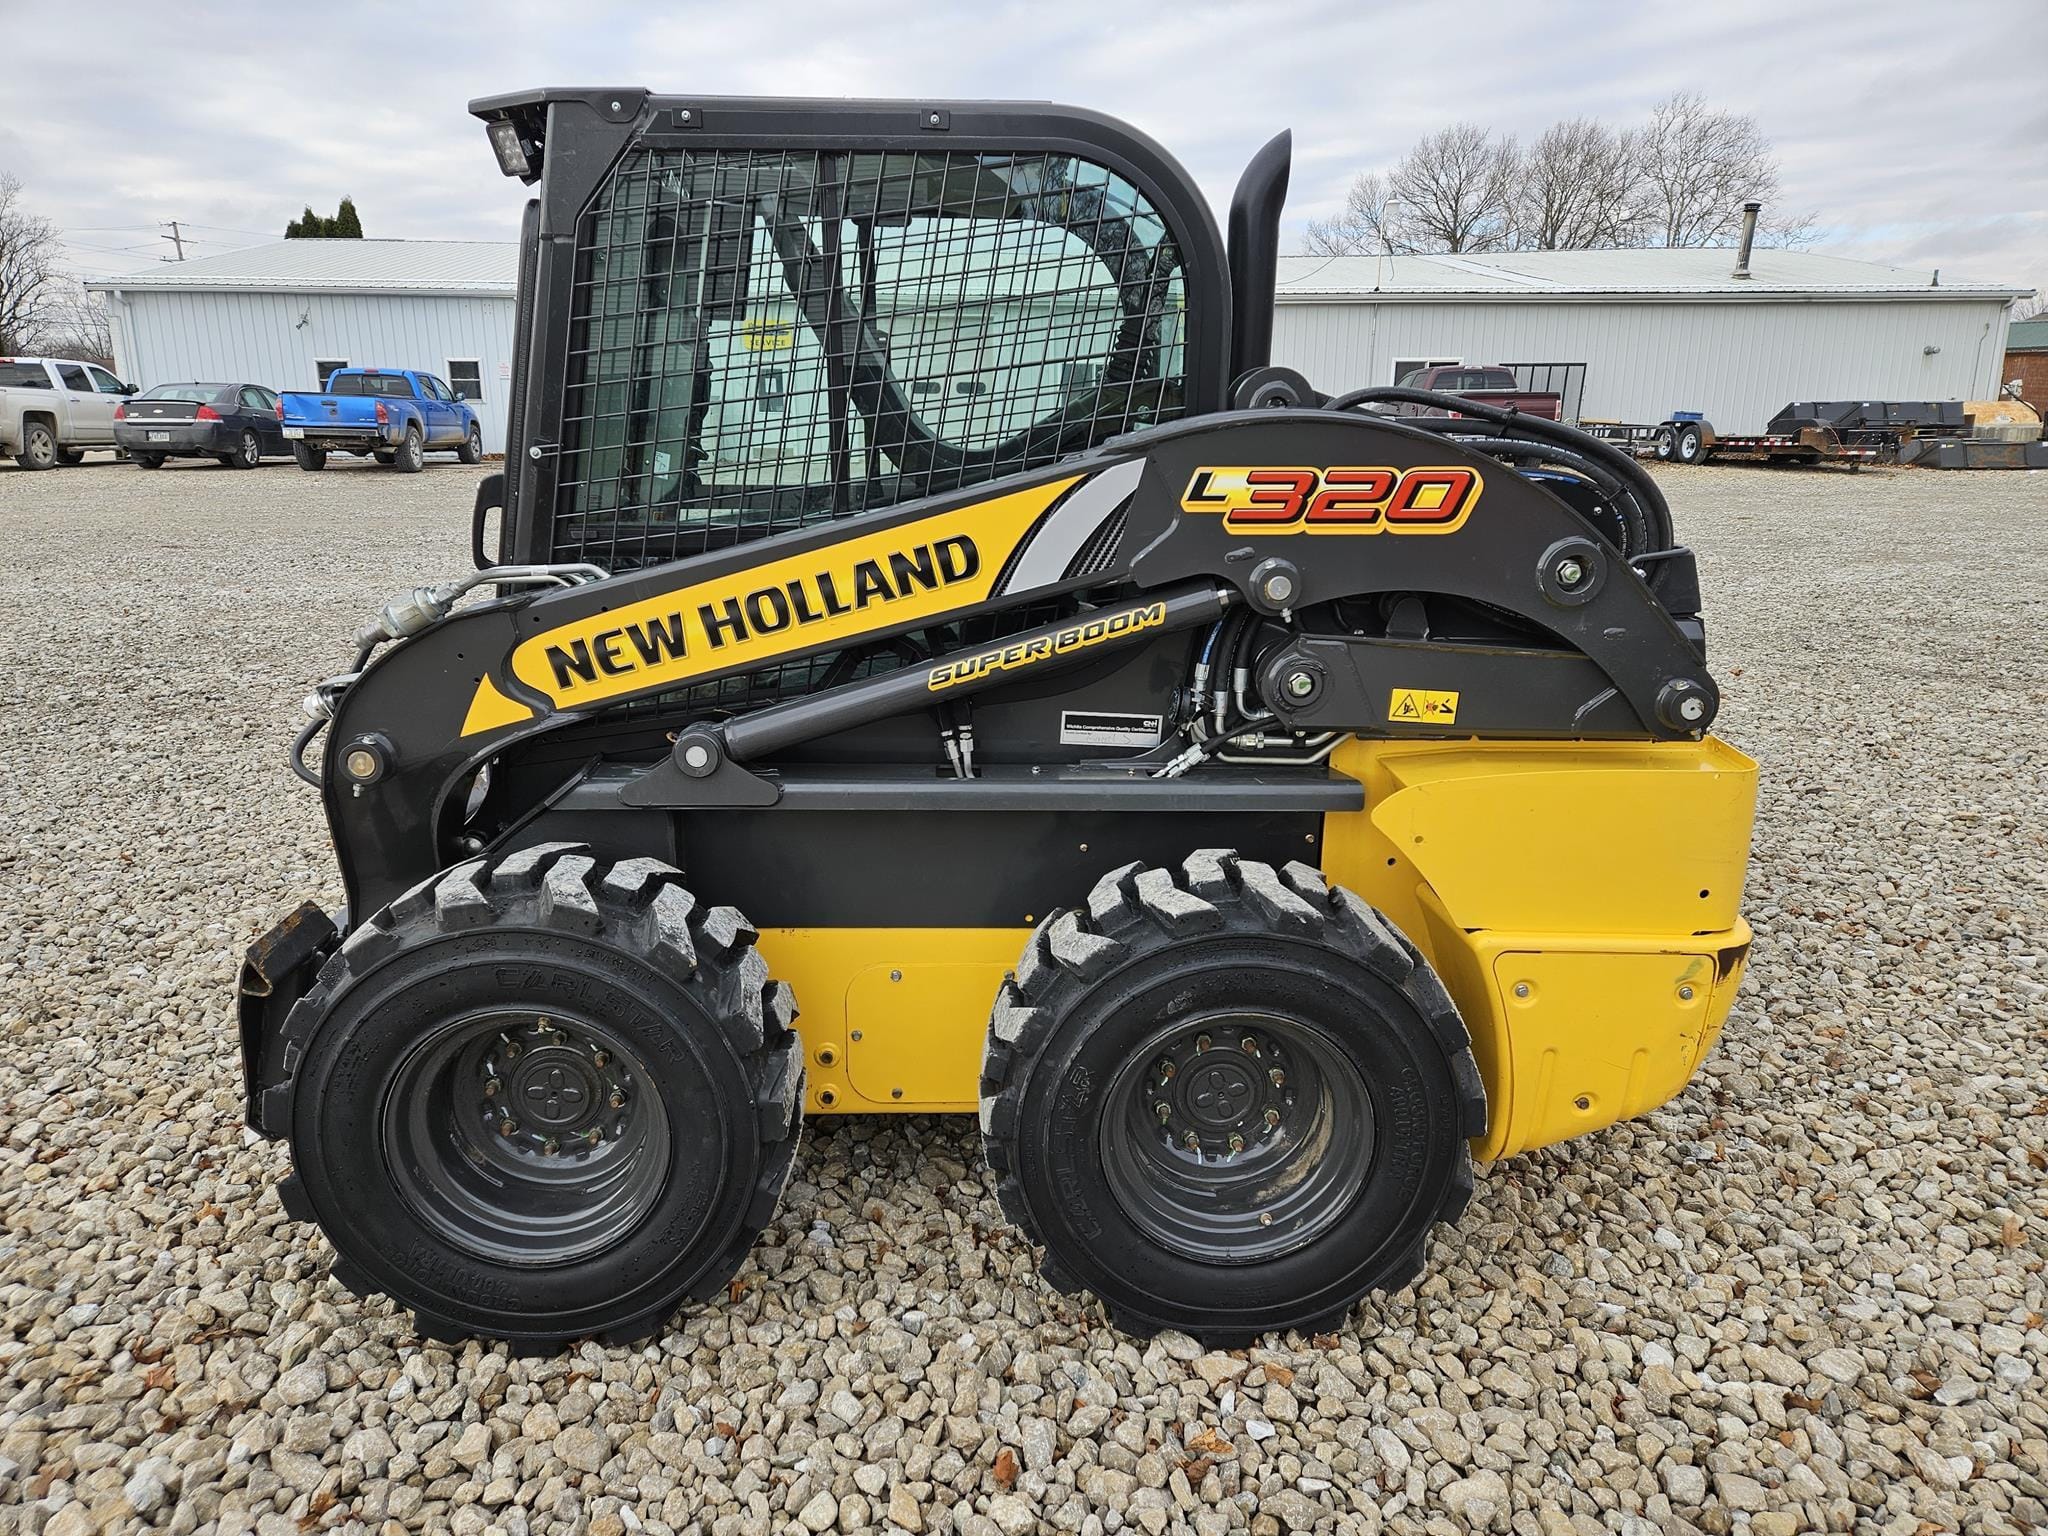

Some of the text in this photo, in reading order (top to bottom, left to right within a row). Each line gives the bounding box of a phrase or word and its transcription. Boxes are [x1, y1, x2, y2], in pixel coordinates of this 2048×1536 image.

[1184, 469, 1480, 528] L320
[545, 534, 980, 690] NEW HOLLAND
[929, 637, 1050, 690] SUPER
[1055, 602, 1167, 653] BOOM
